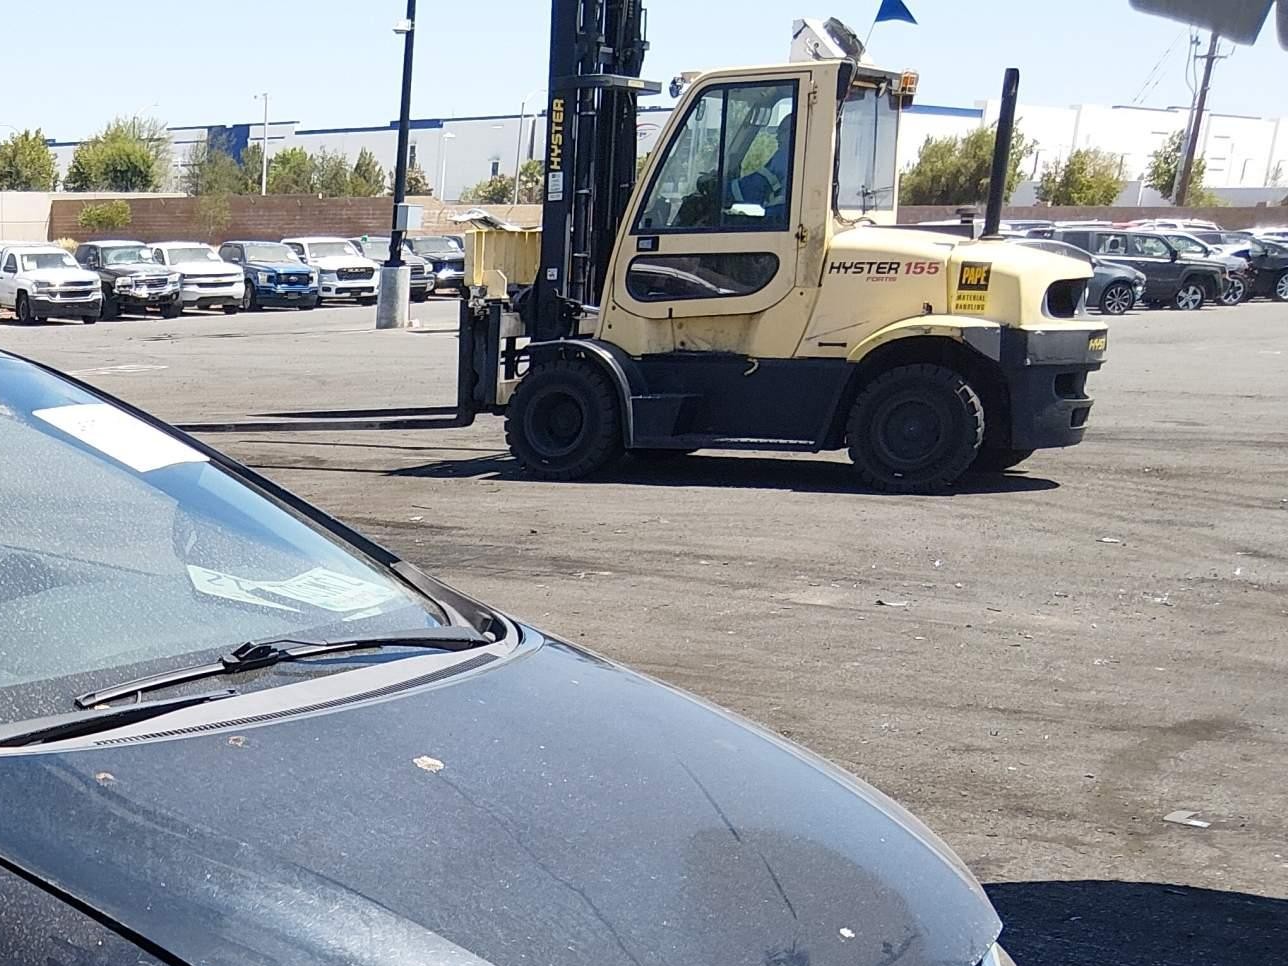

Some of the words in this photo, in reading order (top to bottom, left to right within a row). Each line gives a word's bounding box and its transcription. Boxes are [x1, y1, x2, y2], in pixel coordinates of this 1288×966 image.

[550, 98, 565, 170] HYSTER
[828, 261, 900, 275] HYSTER
[904, 261, 940, 275] 155
